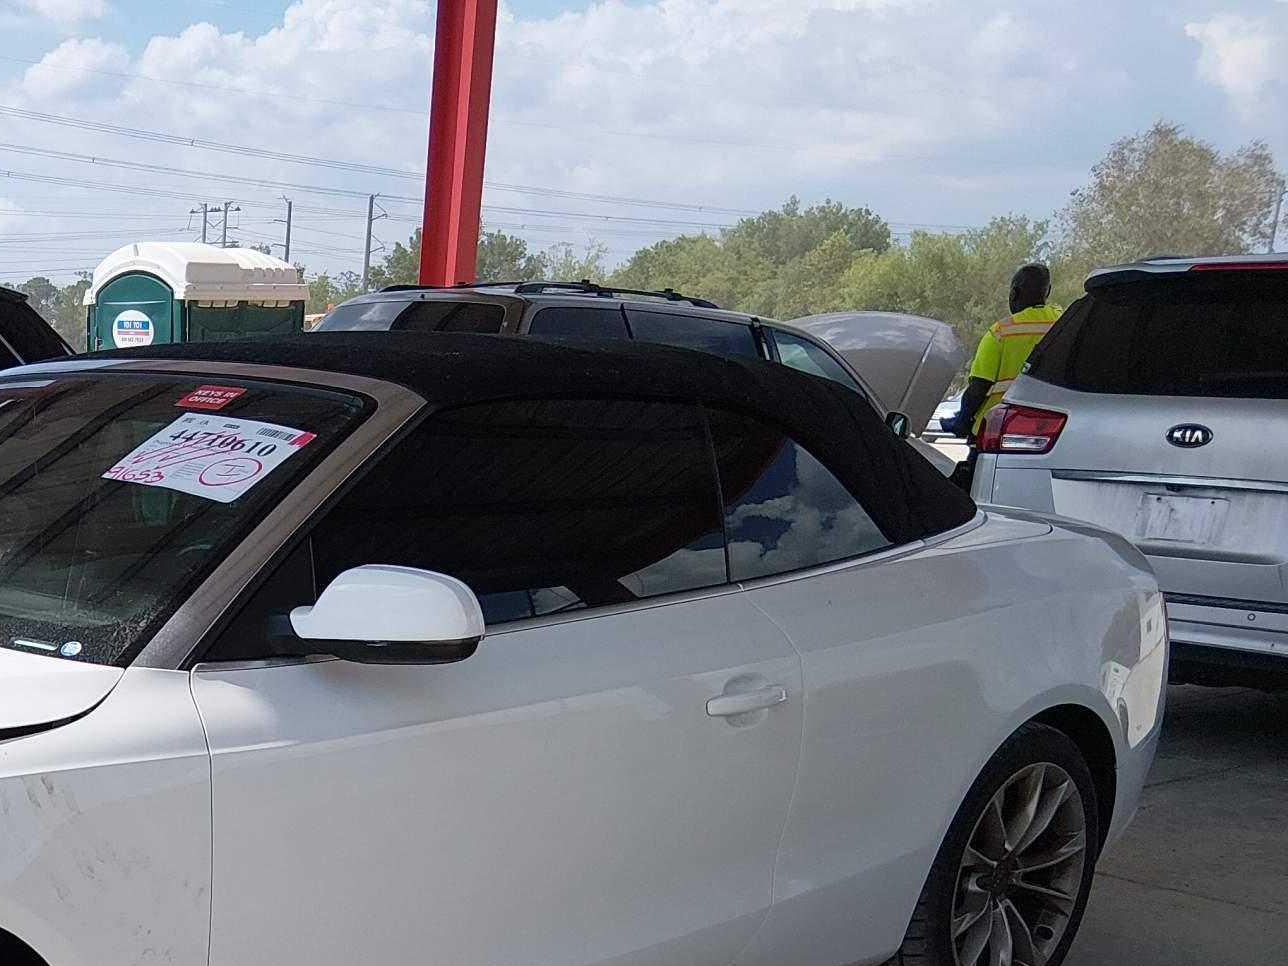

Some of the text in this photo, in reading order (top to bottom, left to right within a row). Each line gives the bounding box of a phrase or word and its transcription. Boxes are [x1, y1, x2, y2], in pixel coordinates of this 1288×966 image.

[194, 389, 223, 397] KEYS
[188, 395, 227, 404] OFFICE
[1173, 429, 1203, 443] KIA
[169, 428, 277, 457] 44710610
